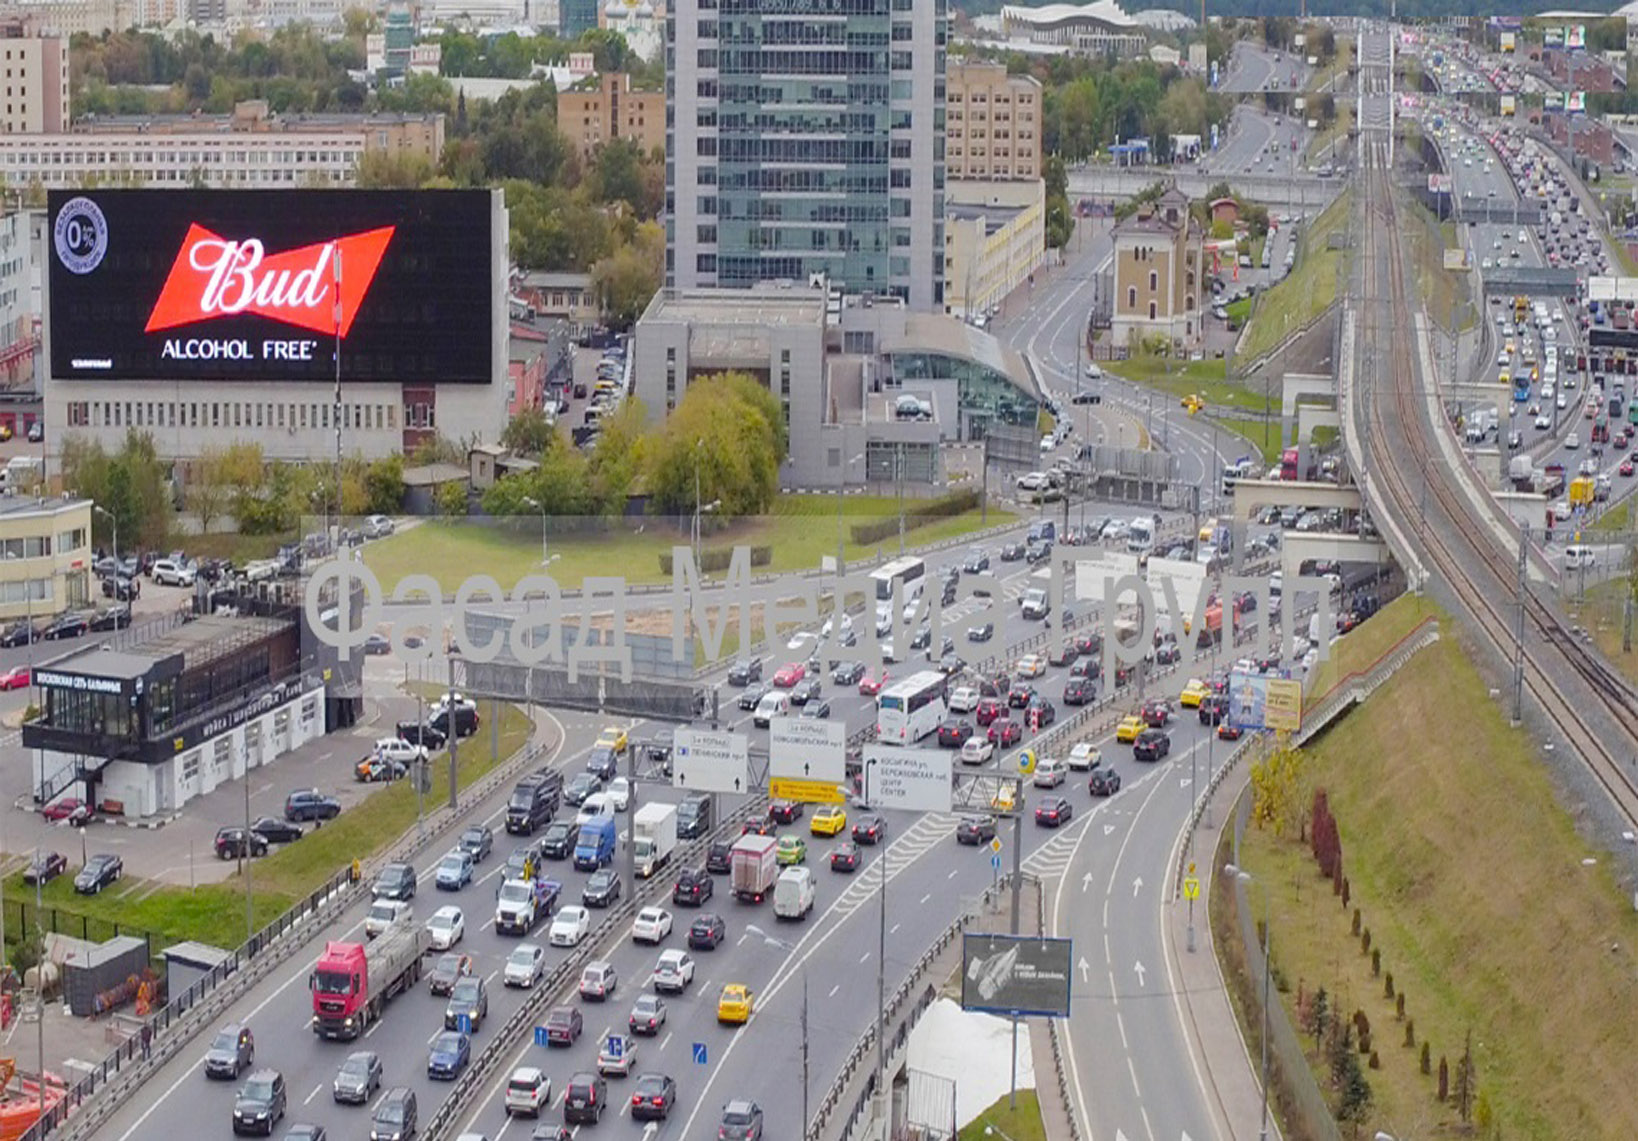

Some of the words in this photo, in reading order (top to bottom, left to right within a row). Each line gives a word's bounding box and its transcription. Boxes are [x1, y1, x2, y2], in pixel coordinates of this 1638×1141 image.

[189, 238, 335, 313] Bud
[161, 339, 253, 360] ALCOHOL
[880, 779, 902, 787] ЦЕНТР
[880, 787, 906, 797] CENTER
